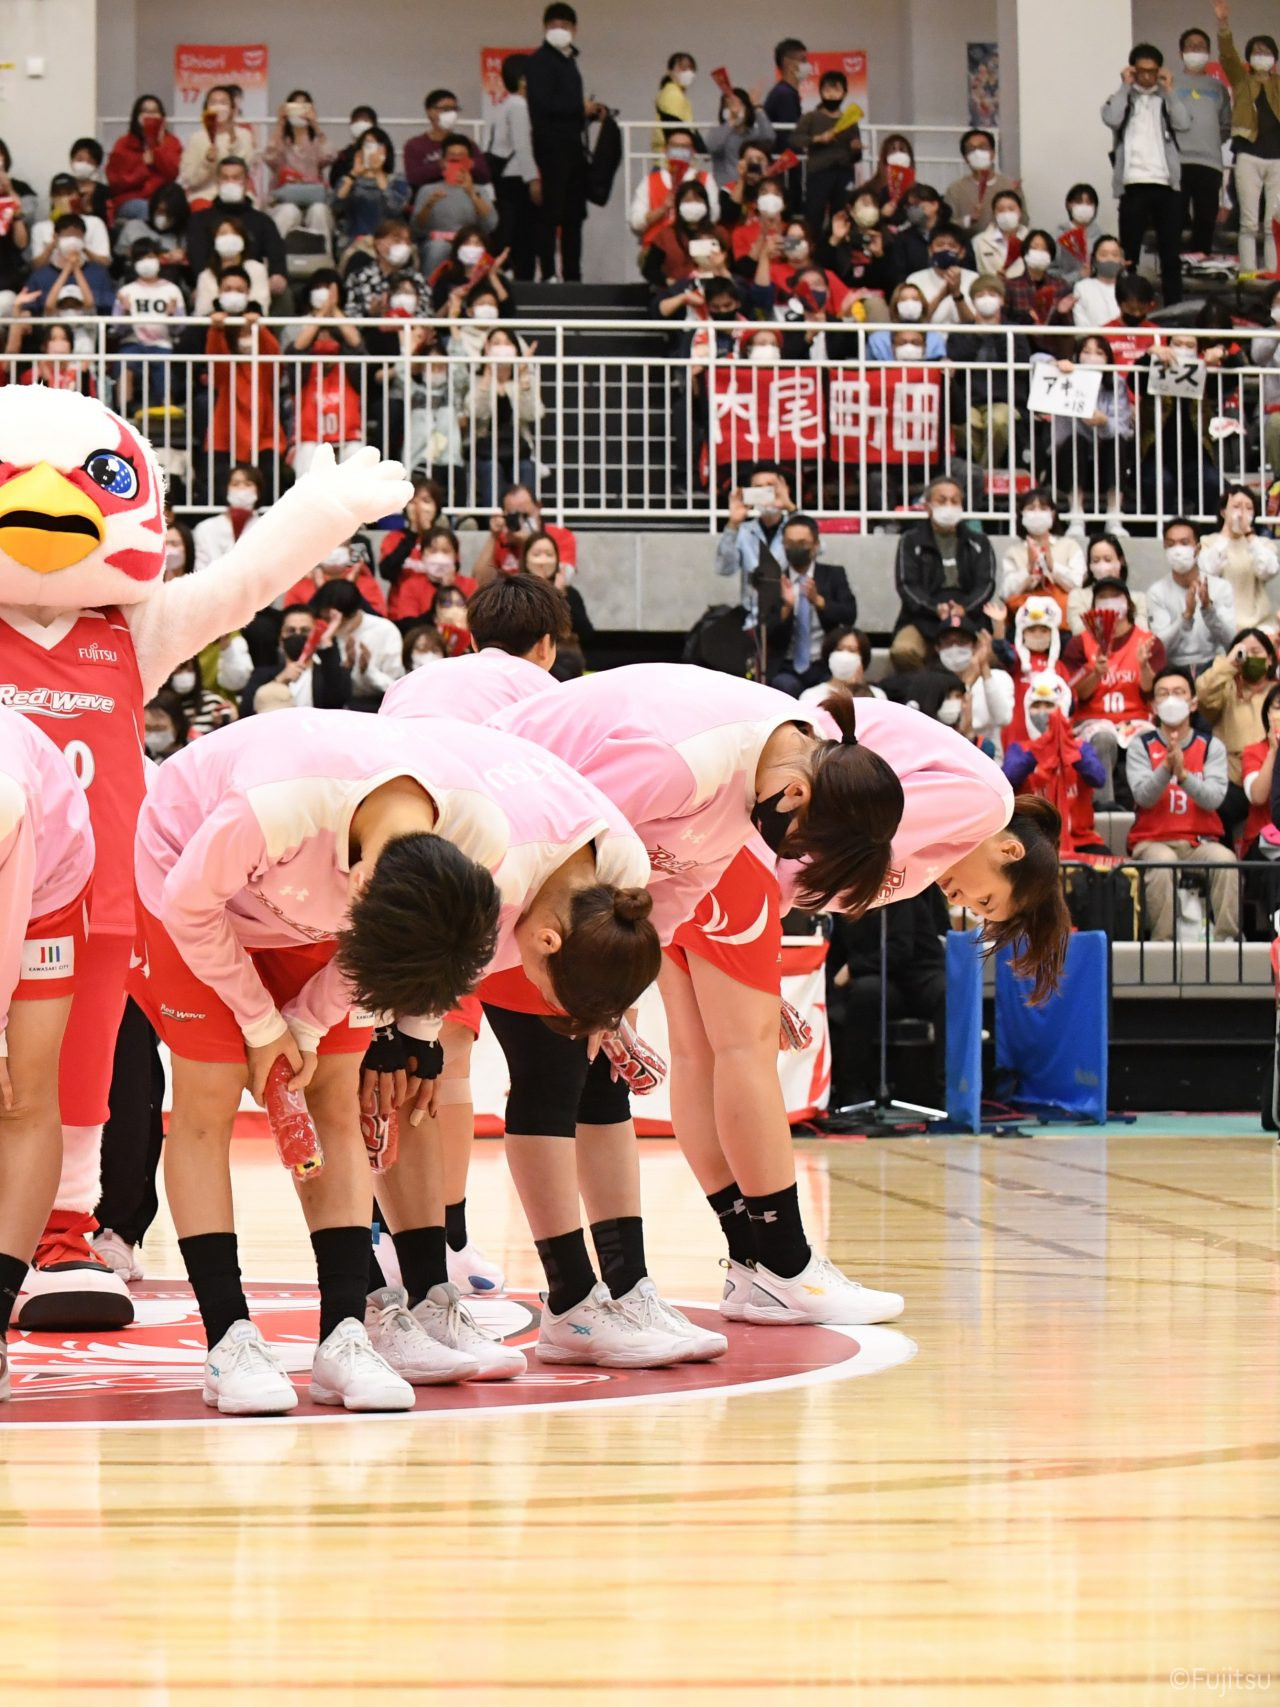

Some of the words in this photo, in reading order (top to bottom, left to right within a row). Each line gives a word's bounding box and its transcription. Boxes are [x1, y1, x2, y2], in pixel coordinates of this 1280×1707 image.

[711, 376, 826, 448] 内尾
[829, 380, 940, 451] 町田
[78, 643, 117, 662] FUJITSU
[50, 690, 116, 713] Wave
[1103, 691, 1125, 713] 10
[1169, 790, 1188, 815] 13
[161, 1003, 175, 1015] Red
[176, 1010, 208, 1020] Wave
